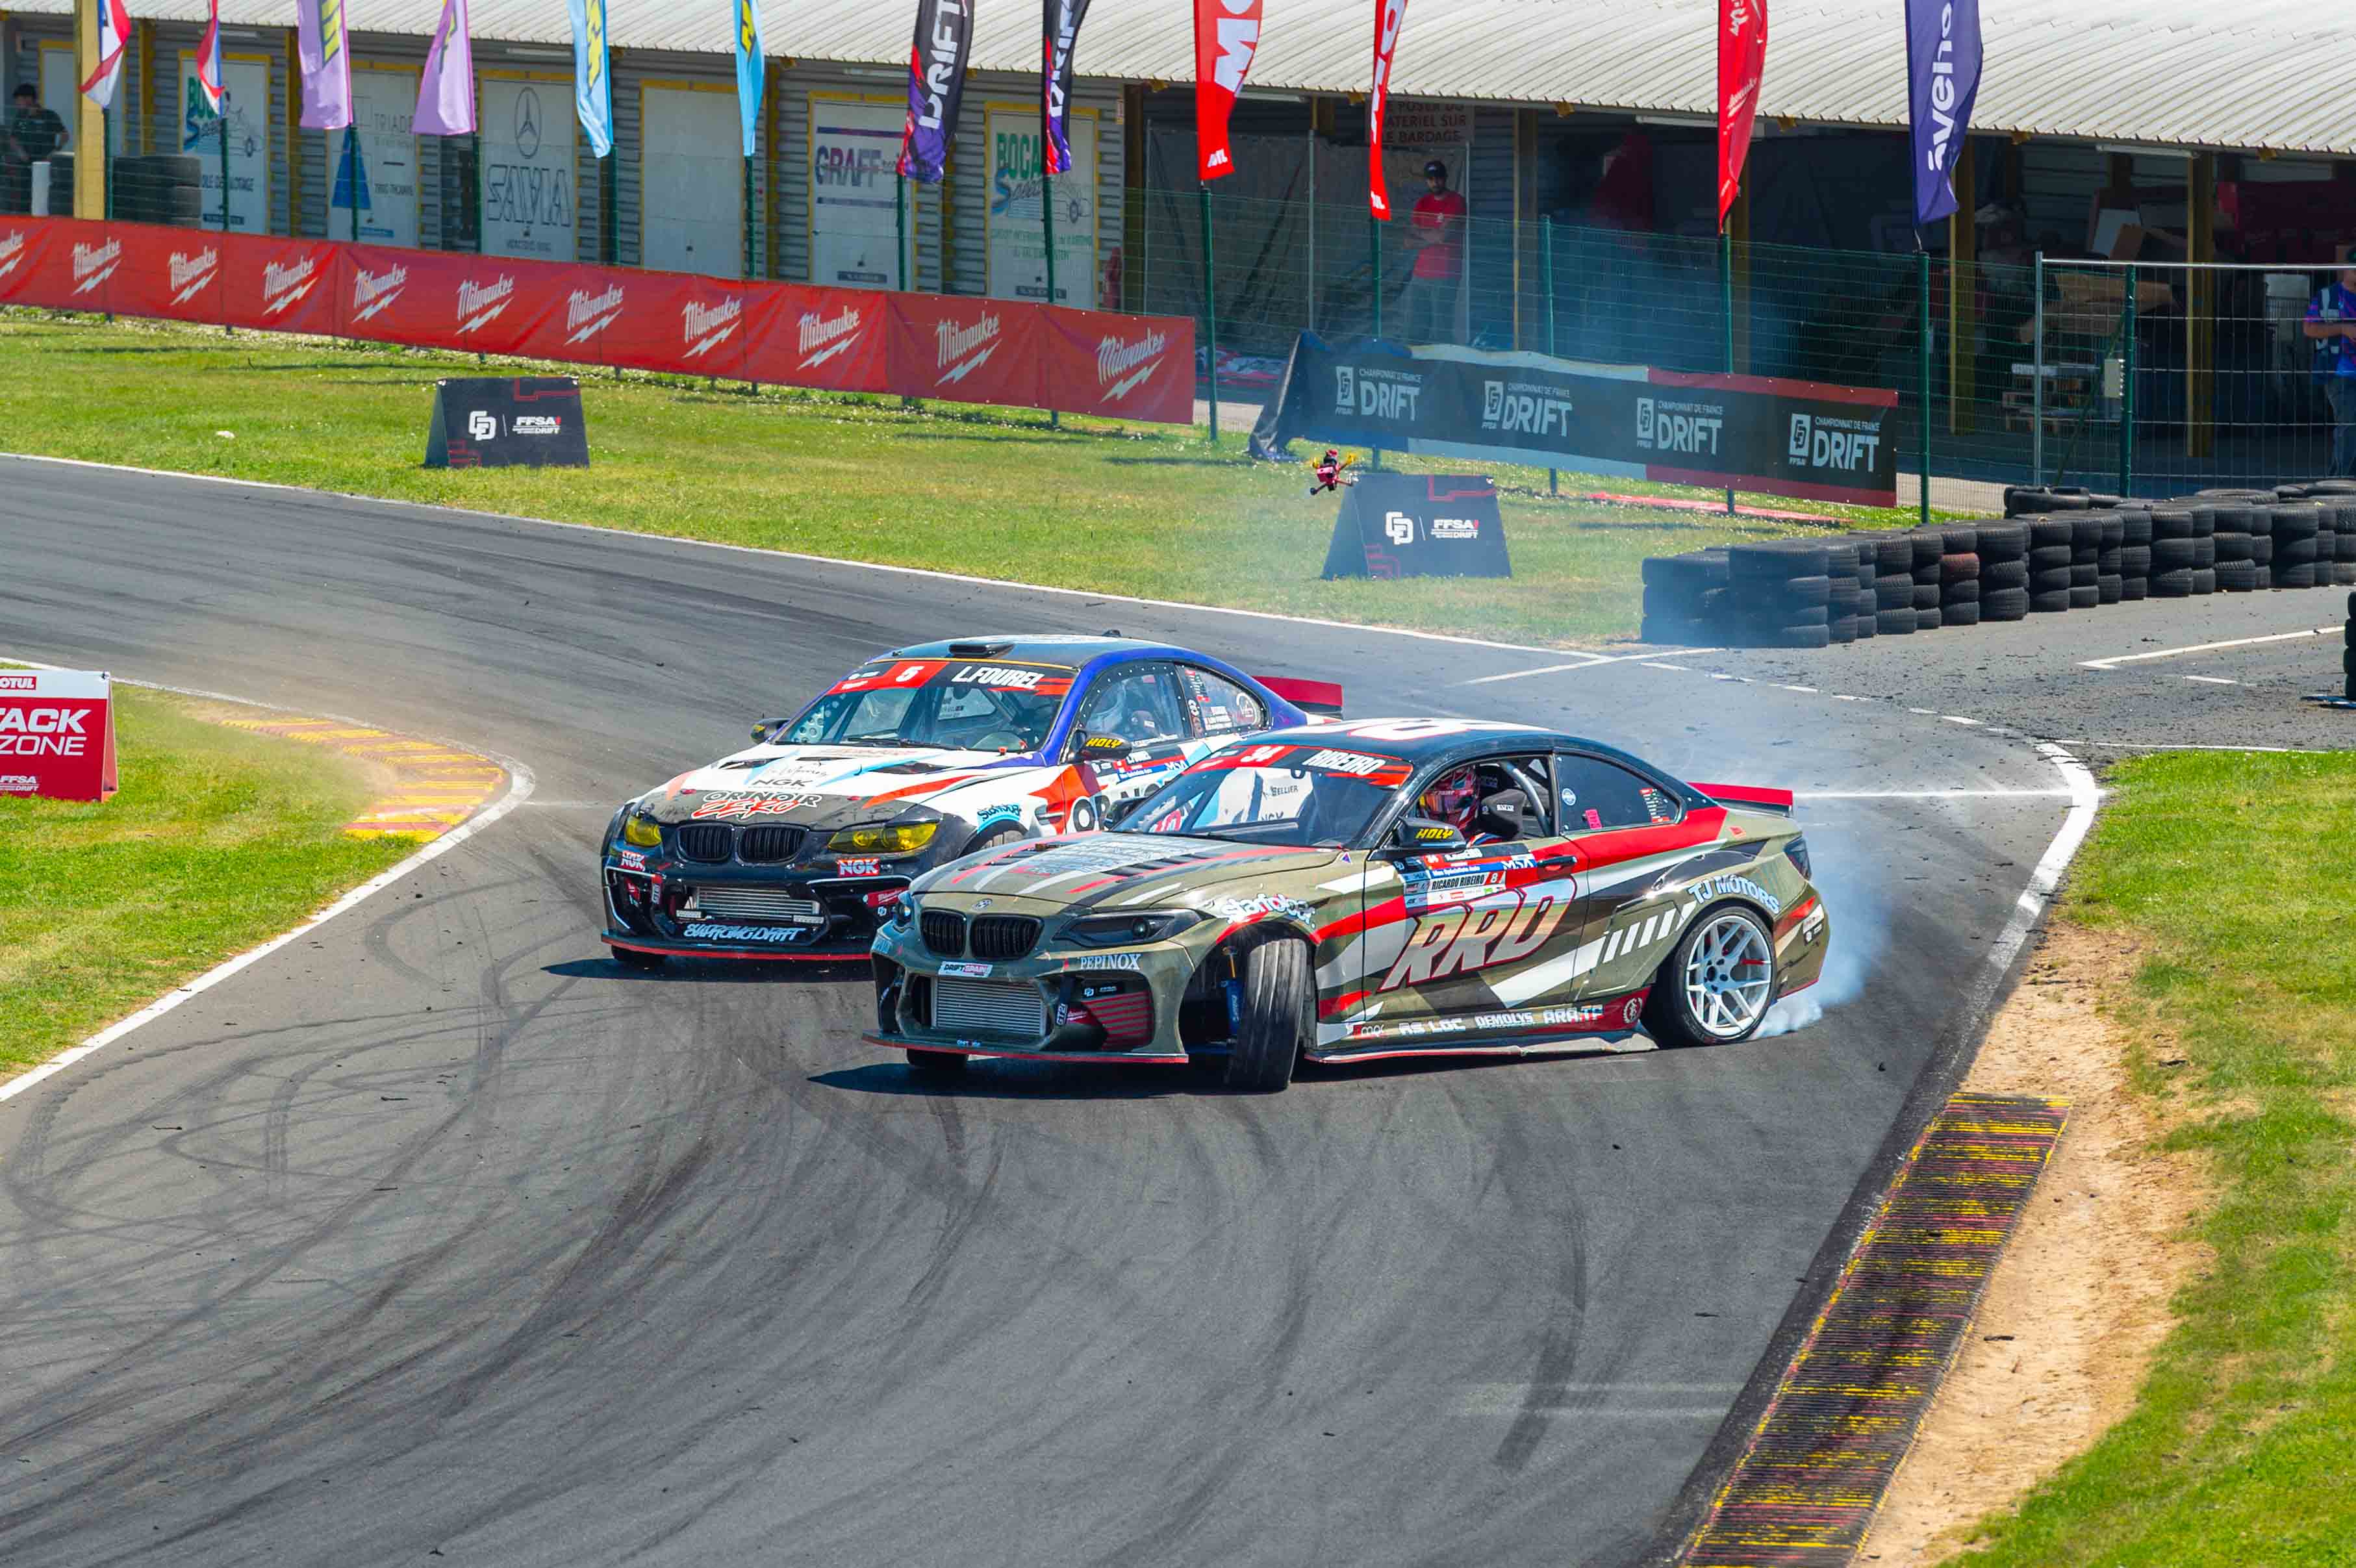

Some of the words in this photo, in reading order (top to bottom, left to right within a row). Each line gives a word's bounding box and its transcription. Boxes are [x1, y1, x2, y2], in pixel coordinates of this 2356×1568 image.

[1385, 114, 1435, 127] ATERIEL
[1440, 114, 1467, 127] SUR
[796, 305, 861, 355] Milwaukee
[934, 310, 1000, 368] Milwaukee
[1095, 327, 1165, 385] Milwaukee
[1360, 380, 1420, 421] DRIFT
[1502, 395, 1573, 437] DRIFT
[1657, 414, 1722, 455] DRIFT
[1812, 429, 1879, 472] DRIFT
[0, 677, 34, 689] OTUL
[895, 665, 925, 682] 5
[0, 708, 92, 733] ACK
[0, 735, 87, 756] ZONE
[1085, 738, 1123, 749] HOLY
[1302, 749, 1386, 776] RIBEIRO
[752, 779, 813, 787] NGK
[1415, 827, 1454, 840] HOLY
[621, 852, 645, 870] NGK
[839, 859, 879, 875] NGK
[1501, 859, 1534, 870] MSA
[1432, 878, 1458, 890] RICARDO
[1461, 874, 1484, 886] RIBEIRO
[1491, 872, 1499, 883] 8
[1689, 879, 1713, 904] TJ
[1714, 874, 1780, 914] MOTORS
[1376, 874, 1578, 994] RRD
[1080, 953, 1141, 970] PEPINOX
[1475, 1011, 1534, 1028] DEMOLYS
